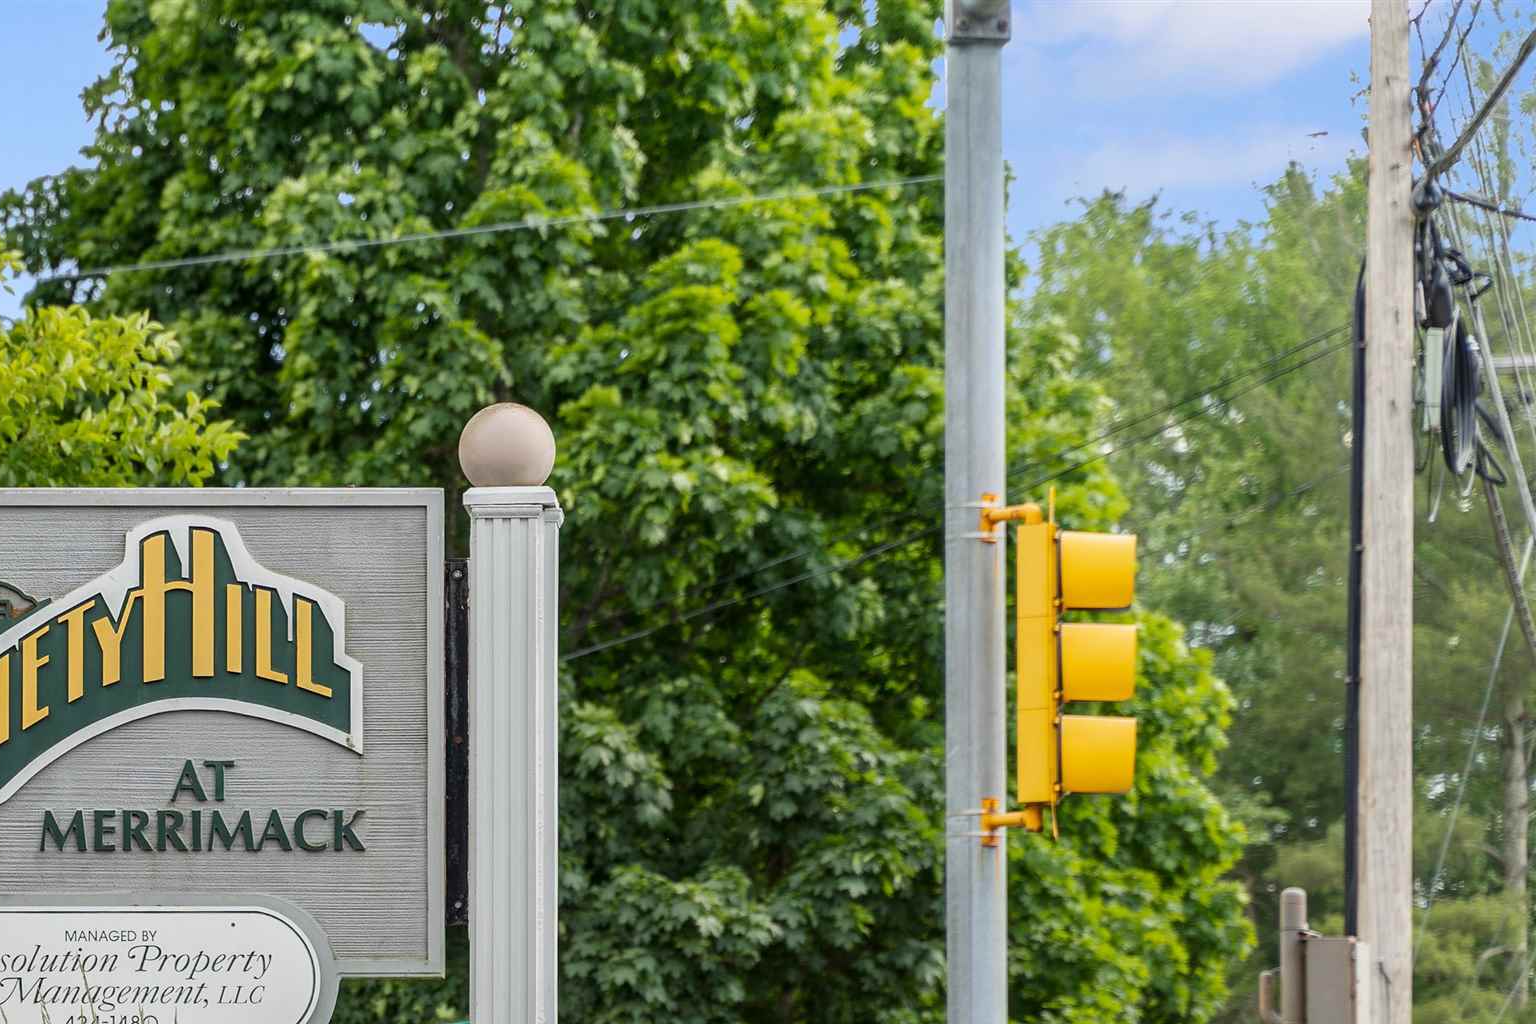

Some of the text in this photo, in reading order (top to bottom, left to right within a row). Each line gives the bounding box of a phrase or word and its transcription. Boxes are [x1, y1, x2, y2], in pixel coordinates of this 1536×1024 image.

[143, 529, 333, 698] HILL
[171, 759, 235, 802] AT
[40, 809, 366, 852] MERRIMACK
[64, 930, 158, 942] MANAGED BY
[128, 945, 272, 981] Property
[217, 985, 266, 1005] LLC
